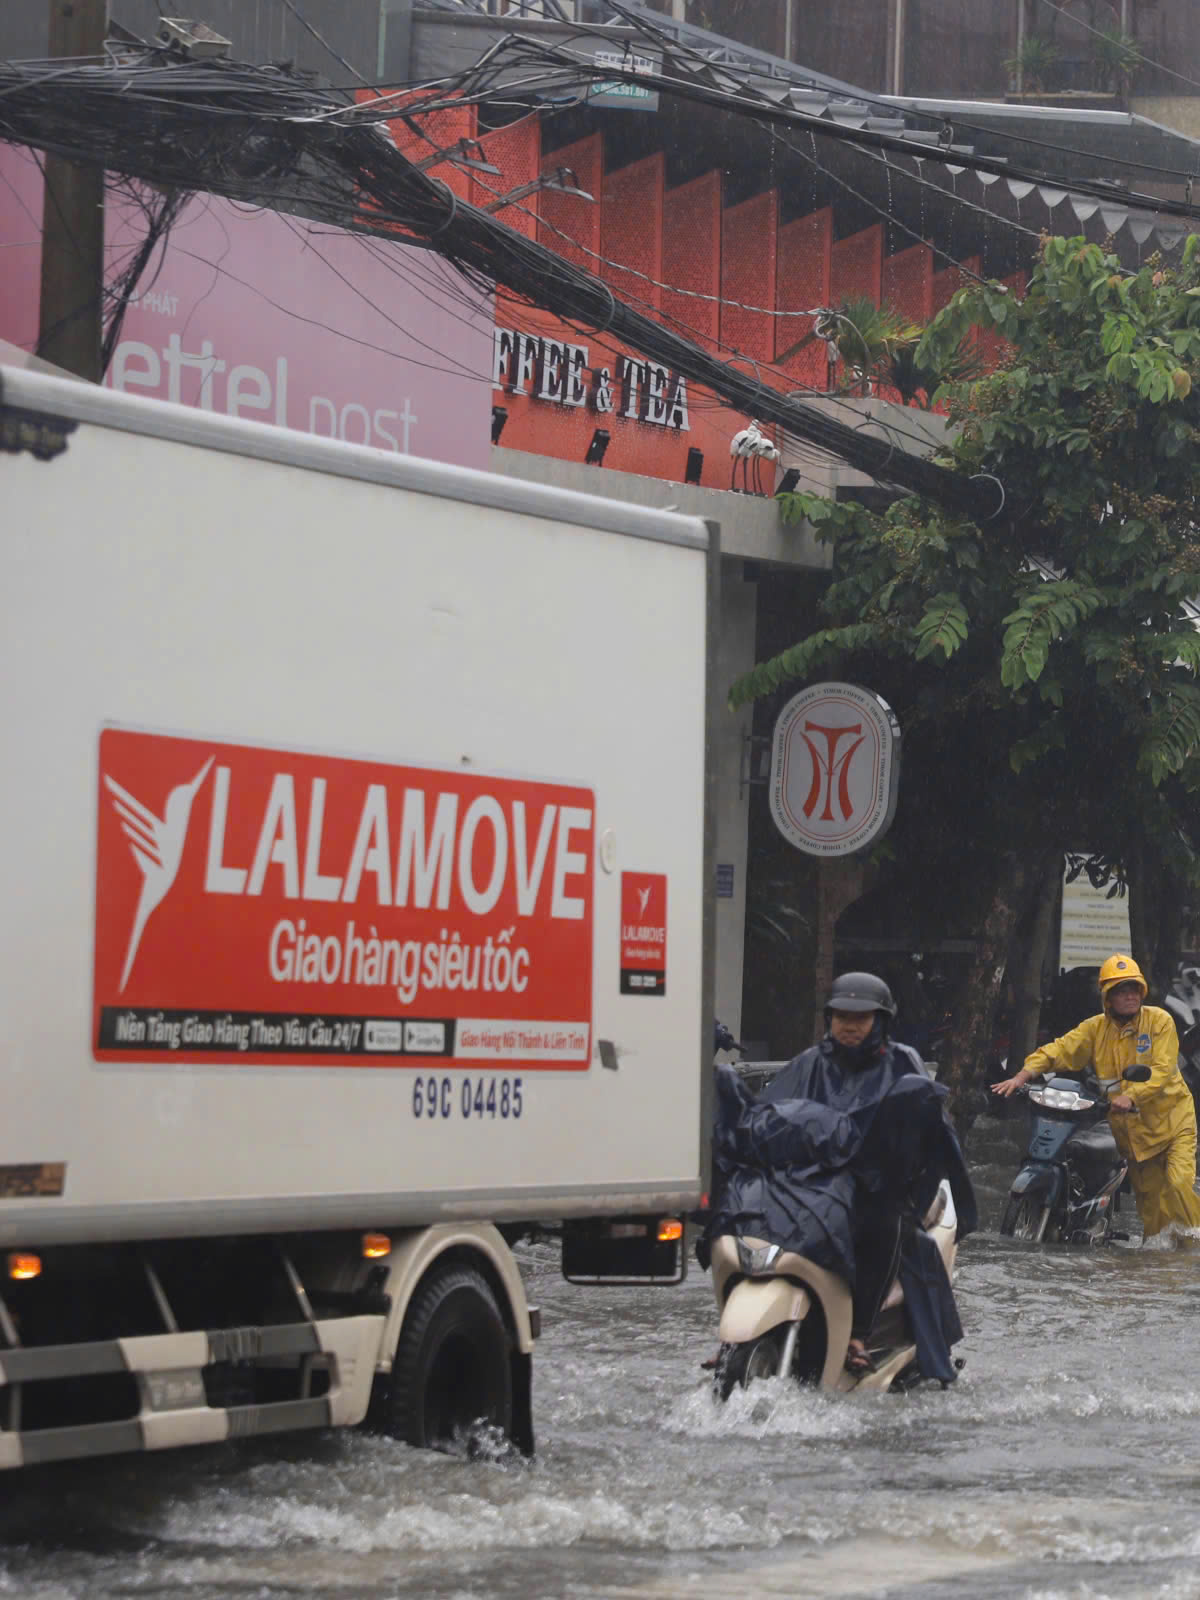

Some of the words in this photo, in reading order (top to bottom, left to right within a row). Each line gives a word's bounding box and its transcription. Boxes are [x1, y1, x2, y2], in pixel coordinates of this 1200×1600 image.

[111, 333, 289, 429] ettel
[492, 327, 589, 408] FFEE
[596, 368, 615, 412] &
[622, 355, 691, 431] TEA
[205, 766, 592, 920] LALAMOVE
[269, 918, 342, 984] Giao
[343, 921, 420, 1004] hàng
[422, 929, 483, 991] siêu
[484, 926, 530, 992] tốc
[115, 1011, 146, 1041] Nền
[147, 1012, 181, 1049] Tảng
[182, 1015, 213, 1042] Giao
[214, 1014, 249, 1050] Hàng
[250, 1018, 283, 1045] Theo
[284, 1018, 307, 1046] Yêu
[308, 1018, 332, 1046] Cầu
[333, 1020, 361, 1051] 24/7
[412, 1077, 452, 1119] 69C
[461, 1077, 523, 1119] 04485
